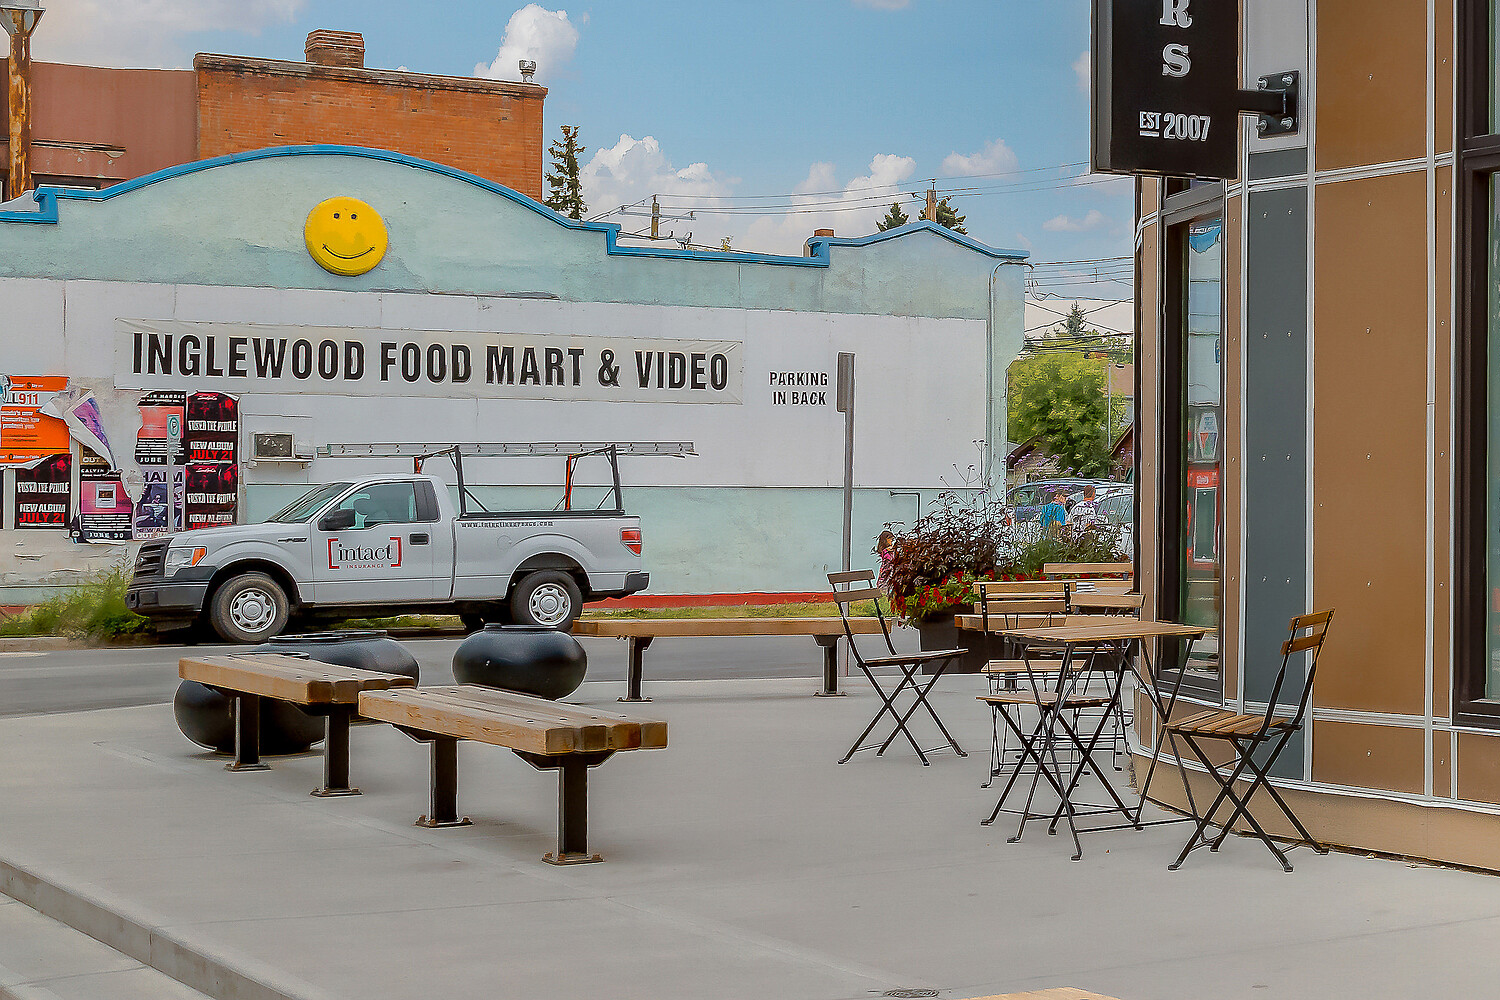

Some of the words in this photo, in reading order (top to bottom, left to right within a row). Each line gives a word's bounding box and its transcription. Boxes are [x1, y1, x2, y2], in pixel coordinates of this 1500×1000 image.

[1139, 111, 1162, 130] EST
[1163, 112, 1211, 142] 2007
[132, 332, 366, 381] INGLEWOOD
[380, 341, 473, 383] FOOD
[486, 345, 585, 388] MART
[597, 348, 620, 388] &
[634, 350, 729, 391] VIDEO
[769, 371, 828, 386] PARKING
[773, 391, 787, 405] IN
[791, 391, 827, 405] BACK
[190, 441, 207, 450] NEW
[207, 442, 234, 451] ALBUM
[190, 450, 218, 460] JULY
[220, 451, 233, 460] 21
[19, 503, 38, 513] NEW
[38, 504, 66, 513] ALBUM
[19, 513, 50, 523] JULY
[53, 513, 65, 523] 21
[189, 514, 206, 523] NEW
